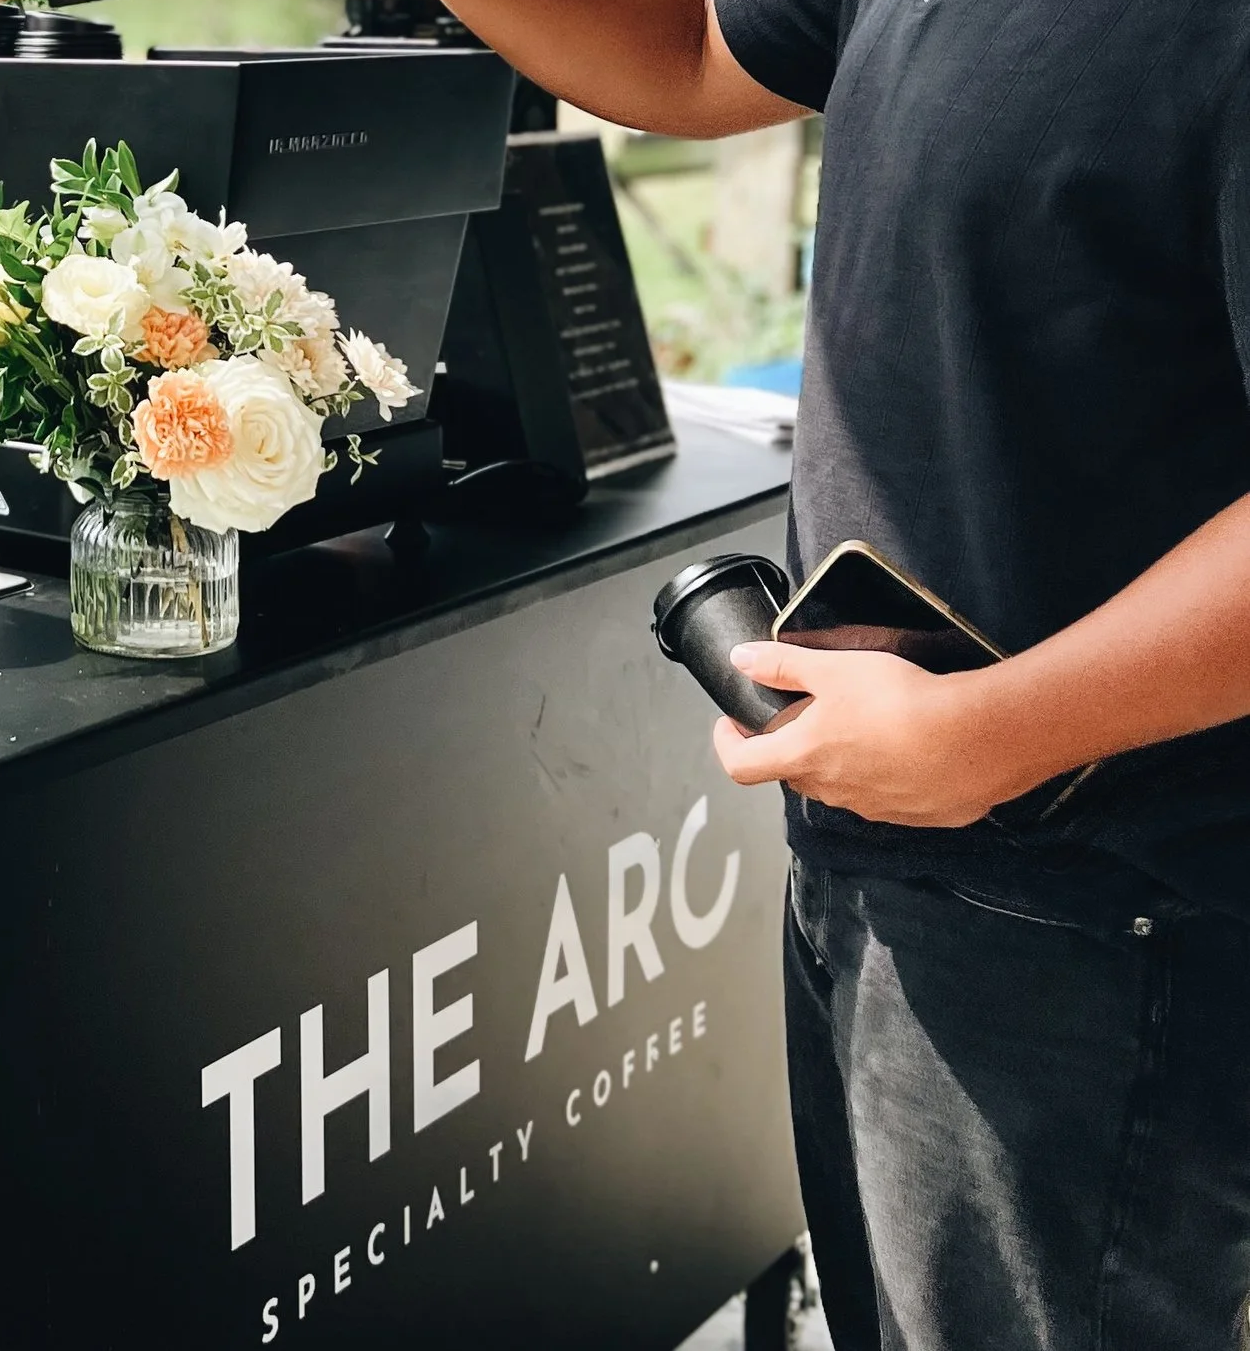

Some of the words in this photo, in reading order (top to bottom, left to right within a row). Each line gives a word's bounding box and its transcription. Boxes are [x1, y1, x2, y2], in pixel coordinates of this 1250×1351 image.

[200, 920, 481, 1252] THE
[524, 795, 741, 1063] ARC
[261, 1120, 534, 1345] SPECIALTY
[564, 1000, 708, 1127] COFFEE
